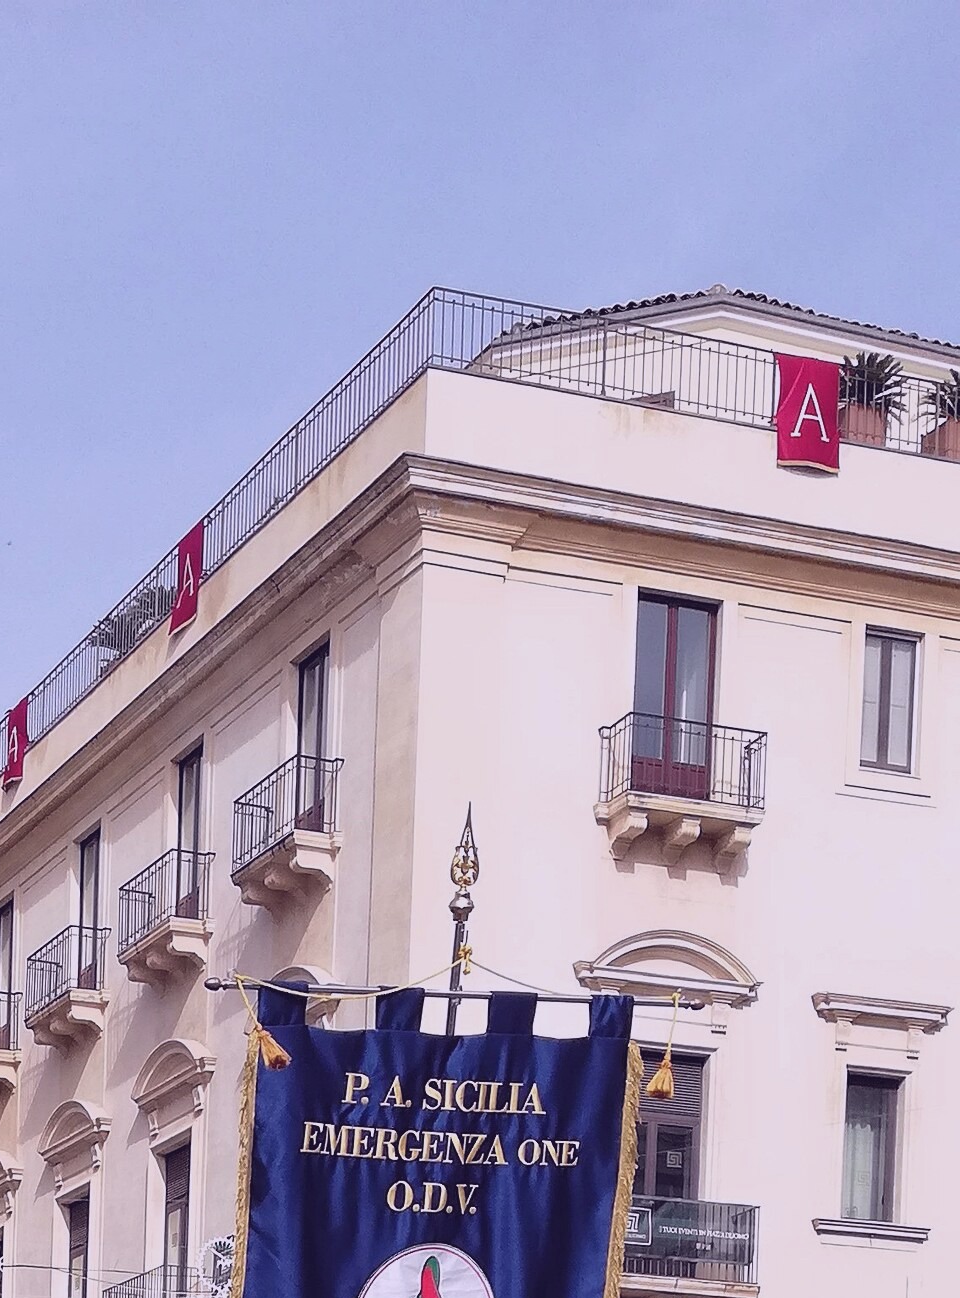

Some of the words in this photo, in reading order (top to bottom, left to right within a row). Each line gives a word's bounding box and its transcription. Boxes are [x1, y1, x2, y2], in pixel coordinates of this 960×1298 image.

[790, 382, 830, 443] A
[175, 553, 195, 609] A
[9, 726, 18, 763] A
[341, 1072, 370, 1105] P.
[380, 1075, 412, 1108] A.
[421, 1078, 547, 1115] SICILIA
[300, 1121, 509, 1166] EMERGENZA
[517, 1138, 581, 1167] ONE
[386, 1180, 479, 1214] O.D.V.
